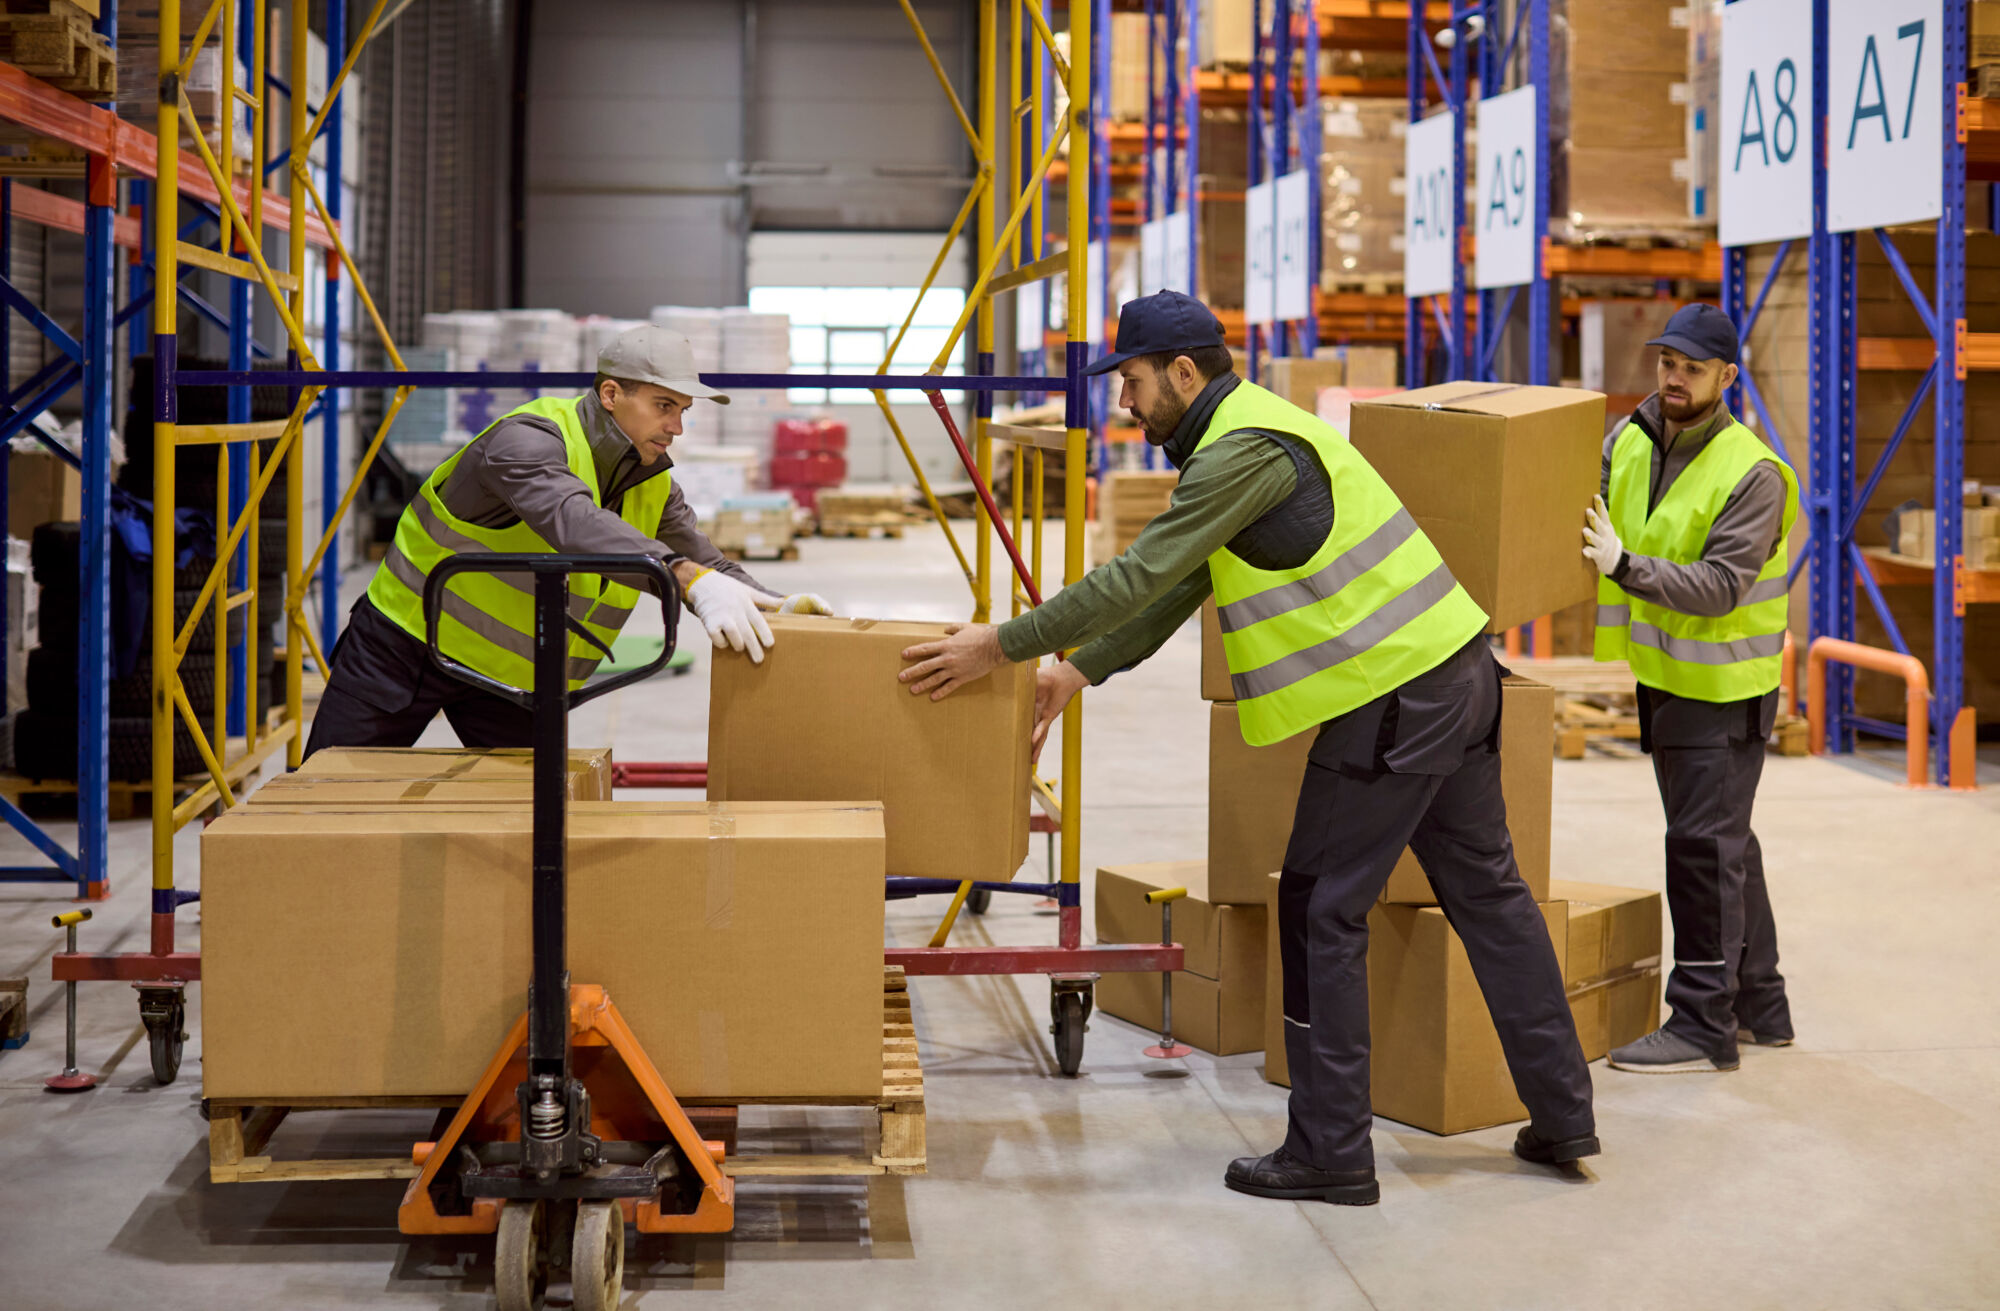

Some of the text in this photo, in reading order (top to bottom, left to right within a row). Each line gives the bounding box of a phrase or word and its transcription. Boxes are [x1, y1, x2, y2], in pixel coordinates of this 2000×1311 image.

[1734, 57, 1797, 173] A8
[1847, 18, 1925, 150] A7
[1411, 166, 1450, 245] A10
[1485, 147, 1527, 231] A9
